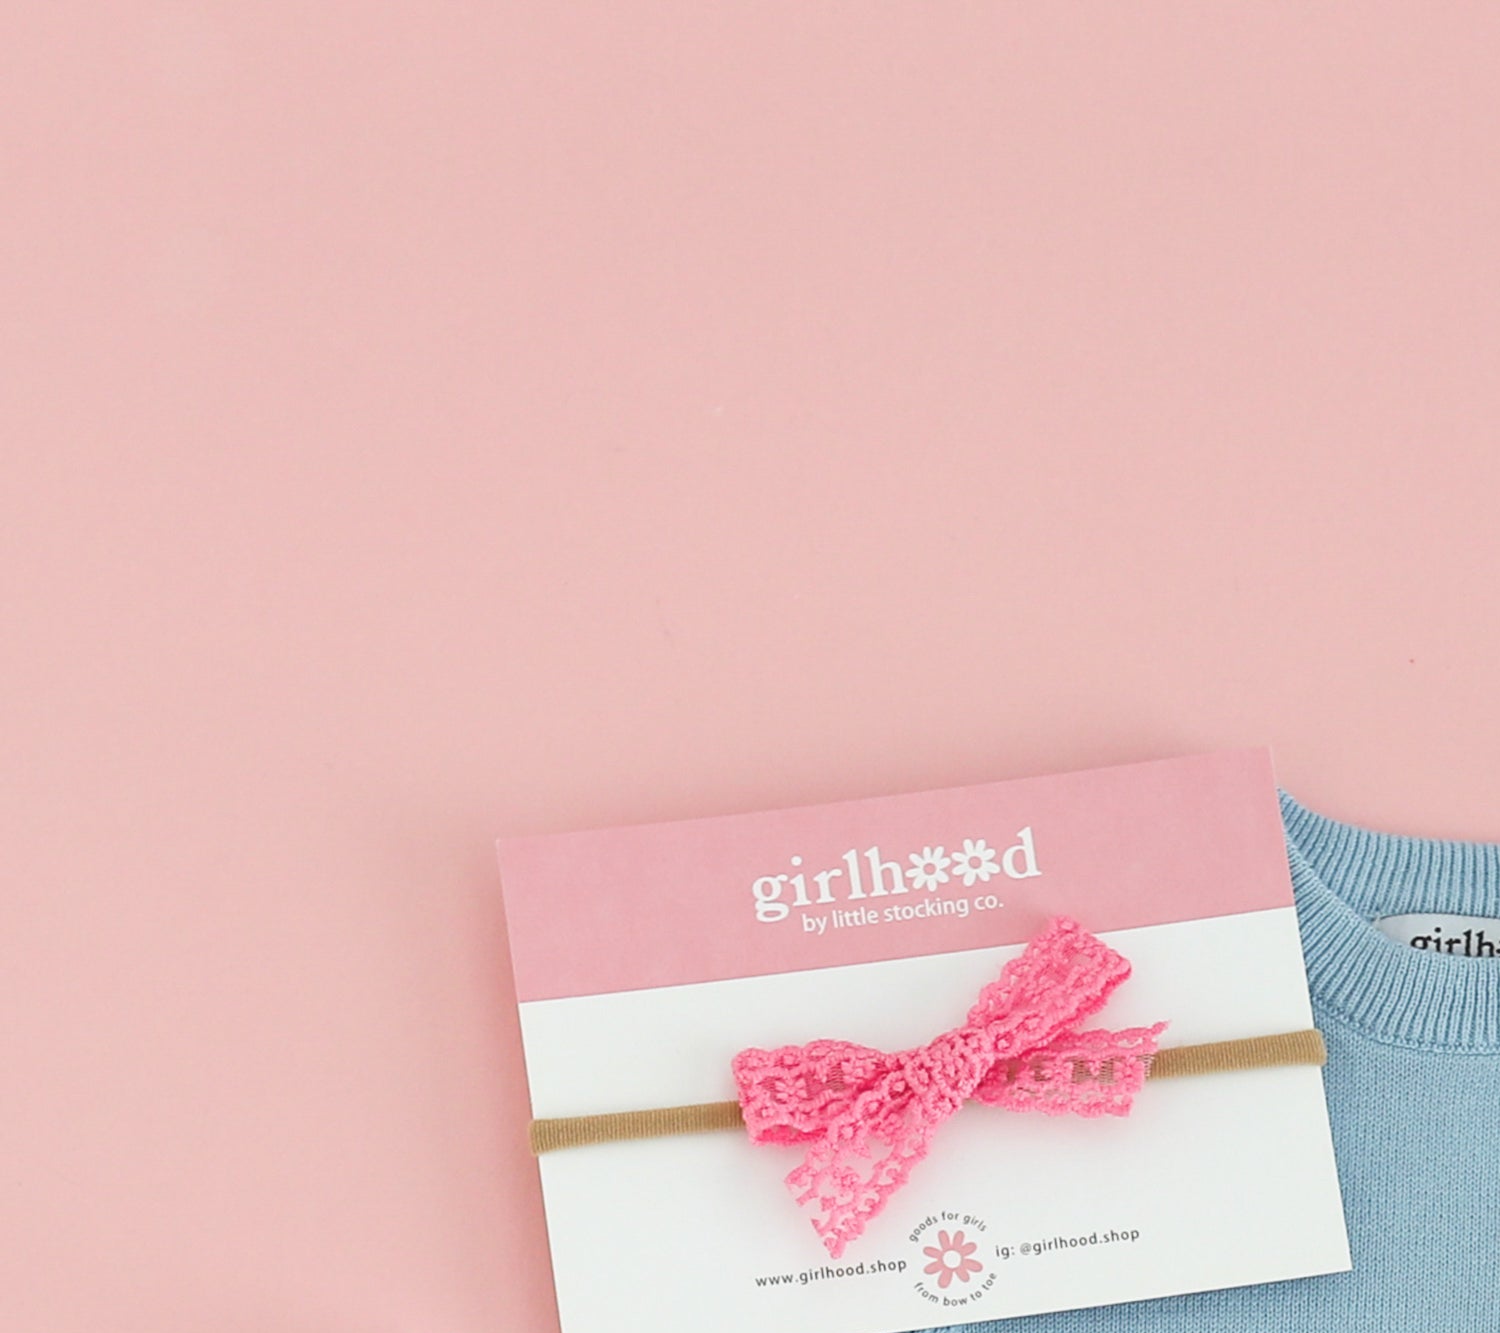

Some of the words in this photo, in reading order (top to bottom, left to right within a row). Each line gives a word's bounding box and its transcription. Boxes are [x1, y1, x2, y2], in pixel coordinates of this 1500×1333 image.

[751, 826, 1042, 923] girlhood
[802, 913, 828, 935] by
[833, 906, 879, 928] little
[884, 898, 969, 922] stocking
[974, 895, 1004, 910] co.
[909, 1215, 938, 1242] goods
[941, 1211, 959, 1221] for
[963, 1214, 987, 1232] girls
[995, 1245, 1016, 1260] ig:
[1020, 1229, 1140, 1256] @girlhood.shop
[755, 1259, 907, 1286] www.girlhood.shop
[914, 1282, 938, 1303] from
[943, 1297, 968, 1307] bow
[970, 1290, 982, 1301] to
[982, 1272, 997, 1290] toe
